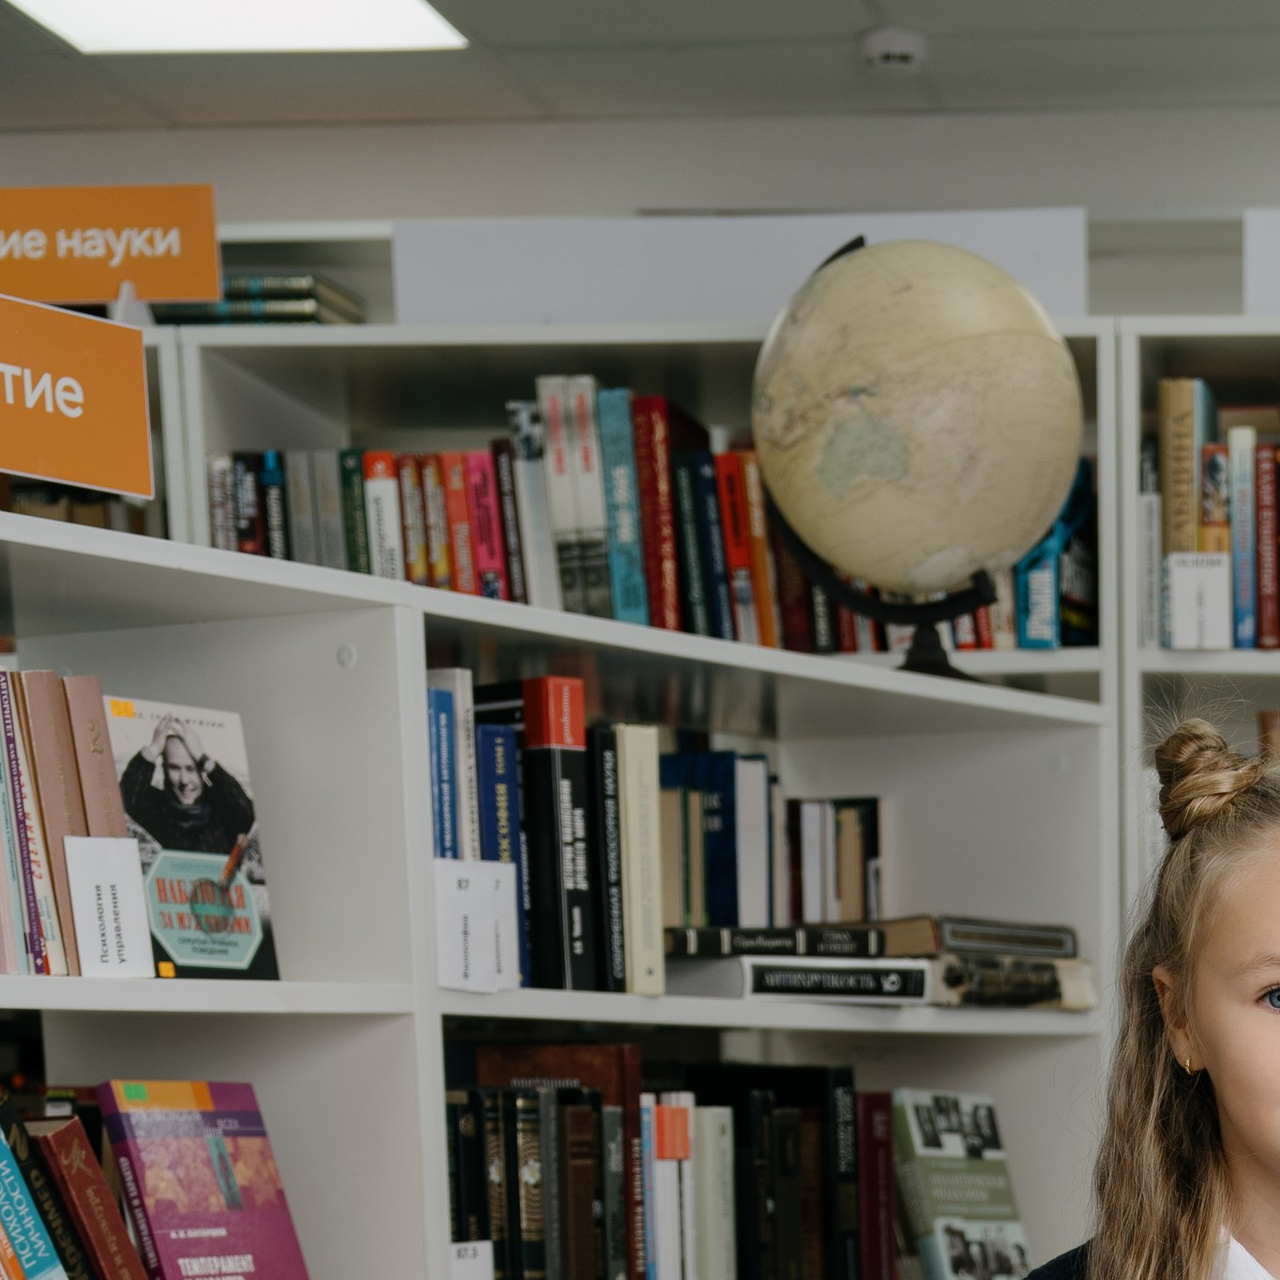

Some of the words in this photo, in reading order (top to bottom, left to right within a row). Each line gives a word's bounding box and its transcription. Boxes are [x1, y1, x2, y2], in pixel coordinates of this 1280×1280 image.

[57, 227, 180, 267] науки
[0, 363, 84, 419] тие
[0, 674, 14, 738] АВТОРИТЕТ
[8, 743, 16, 757] КАК
[604, 749, 615, 795] НАУКИ
[607, 798, 619, 880] ФИЛОСОФИЯ
[96, 884, 109, 964] Психология
[109, 883, 125, 964] управления
[159, 911, 174, 930] ЗА
[0, 1158, 52, 1261] ЛИЧНОСТИ
[113, 1253, 126, 1267] и
[178, 1254, 254, 1277] ТЕМПЕРАМЕНТ
